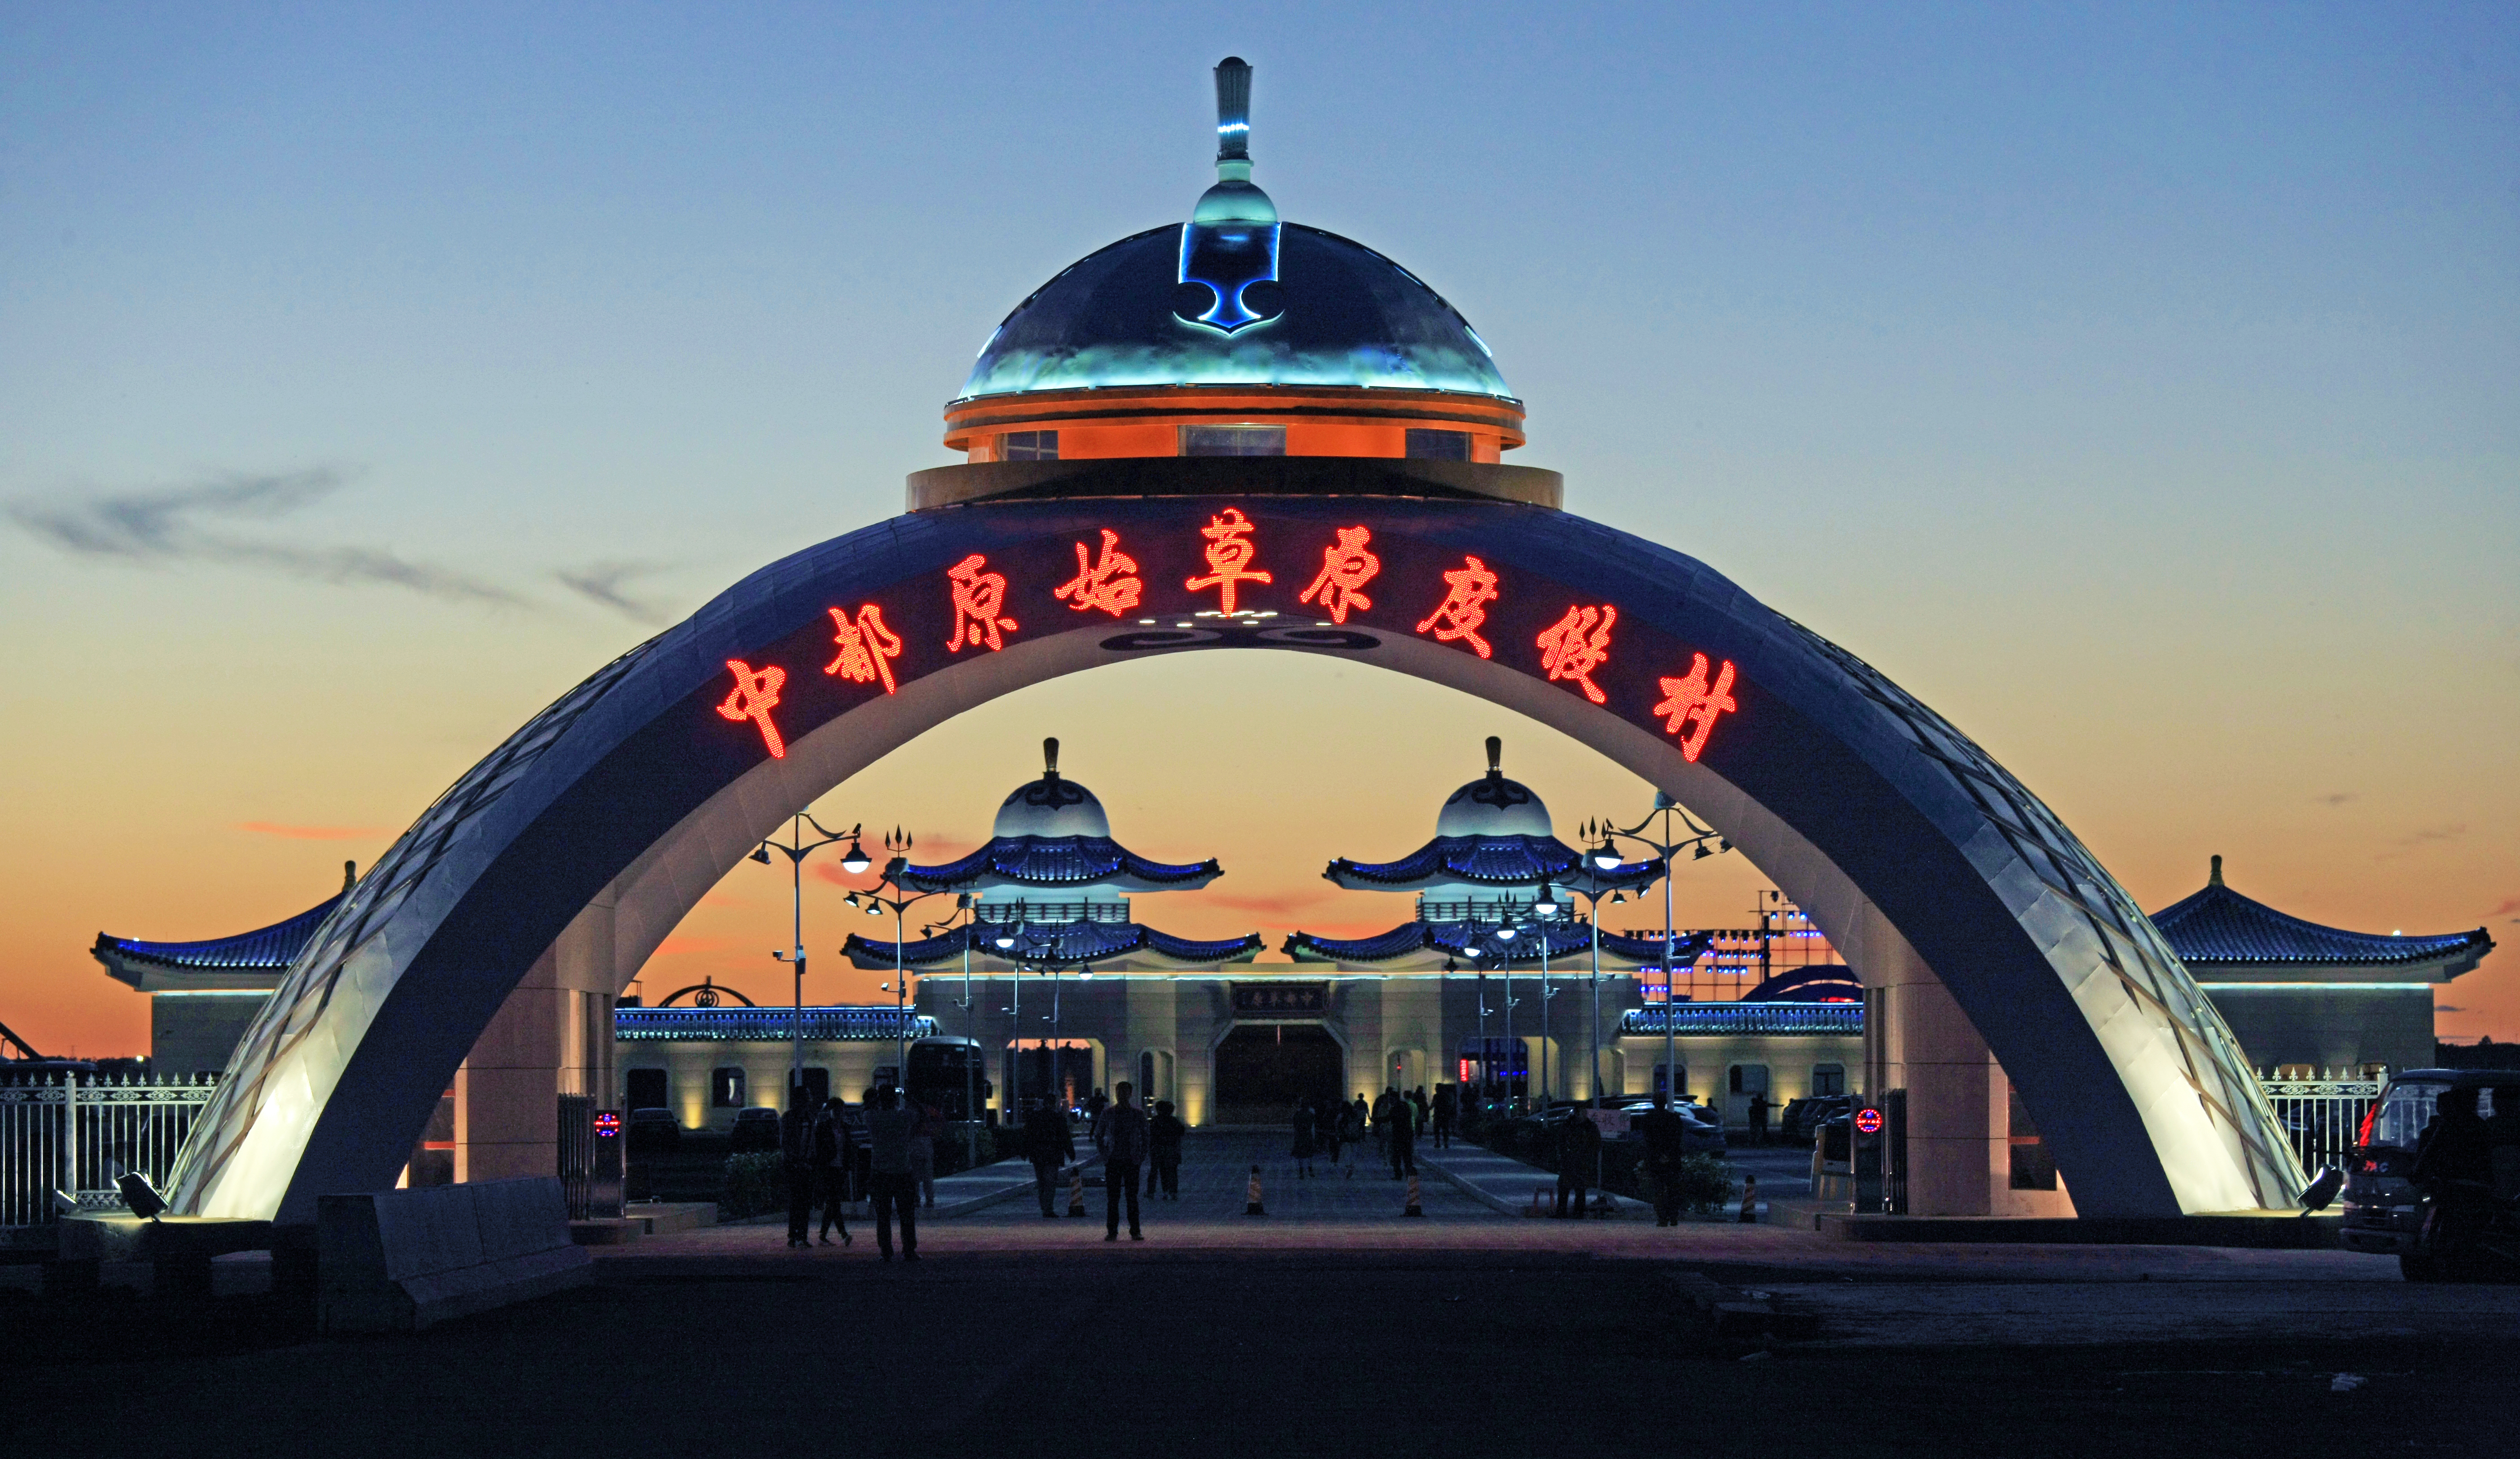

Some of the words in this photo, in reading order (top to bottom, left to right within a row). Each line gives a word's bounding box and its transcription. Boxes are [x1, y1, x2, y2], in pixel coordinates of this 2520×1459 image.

[715, 506, 1738, 764] 中都原始草原度假村
